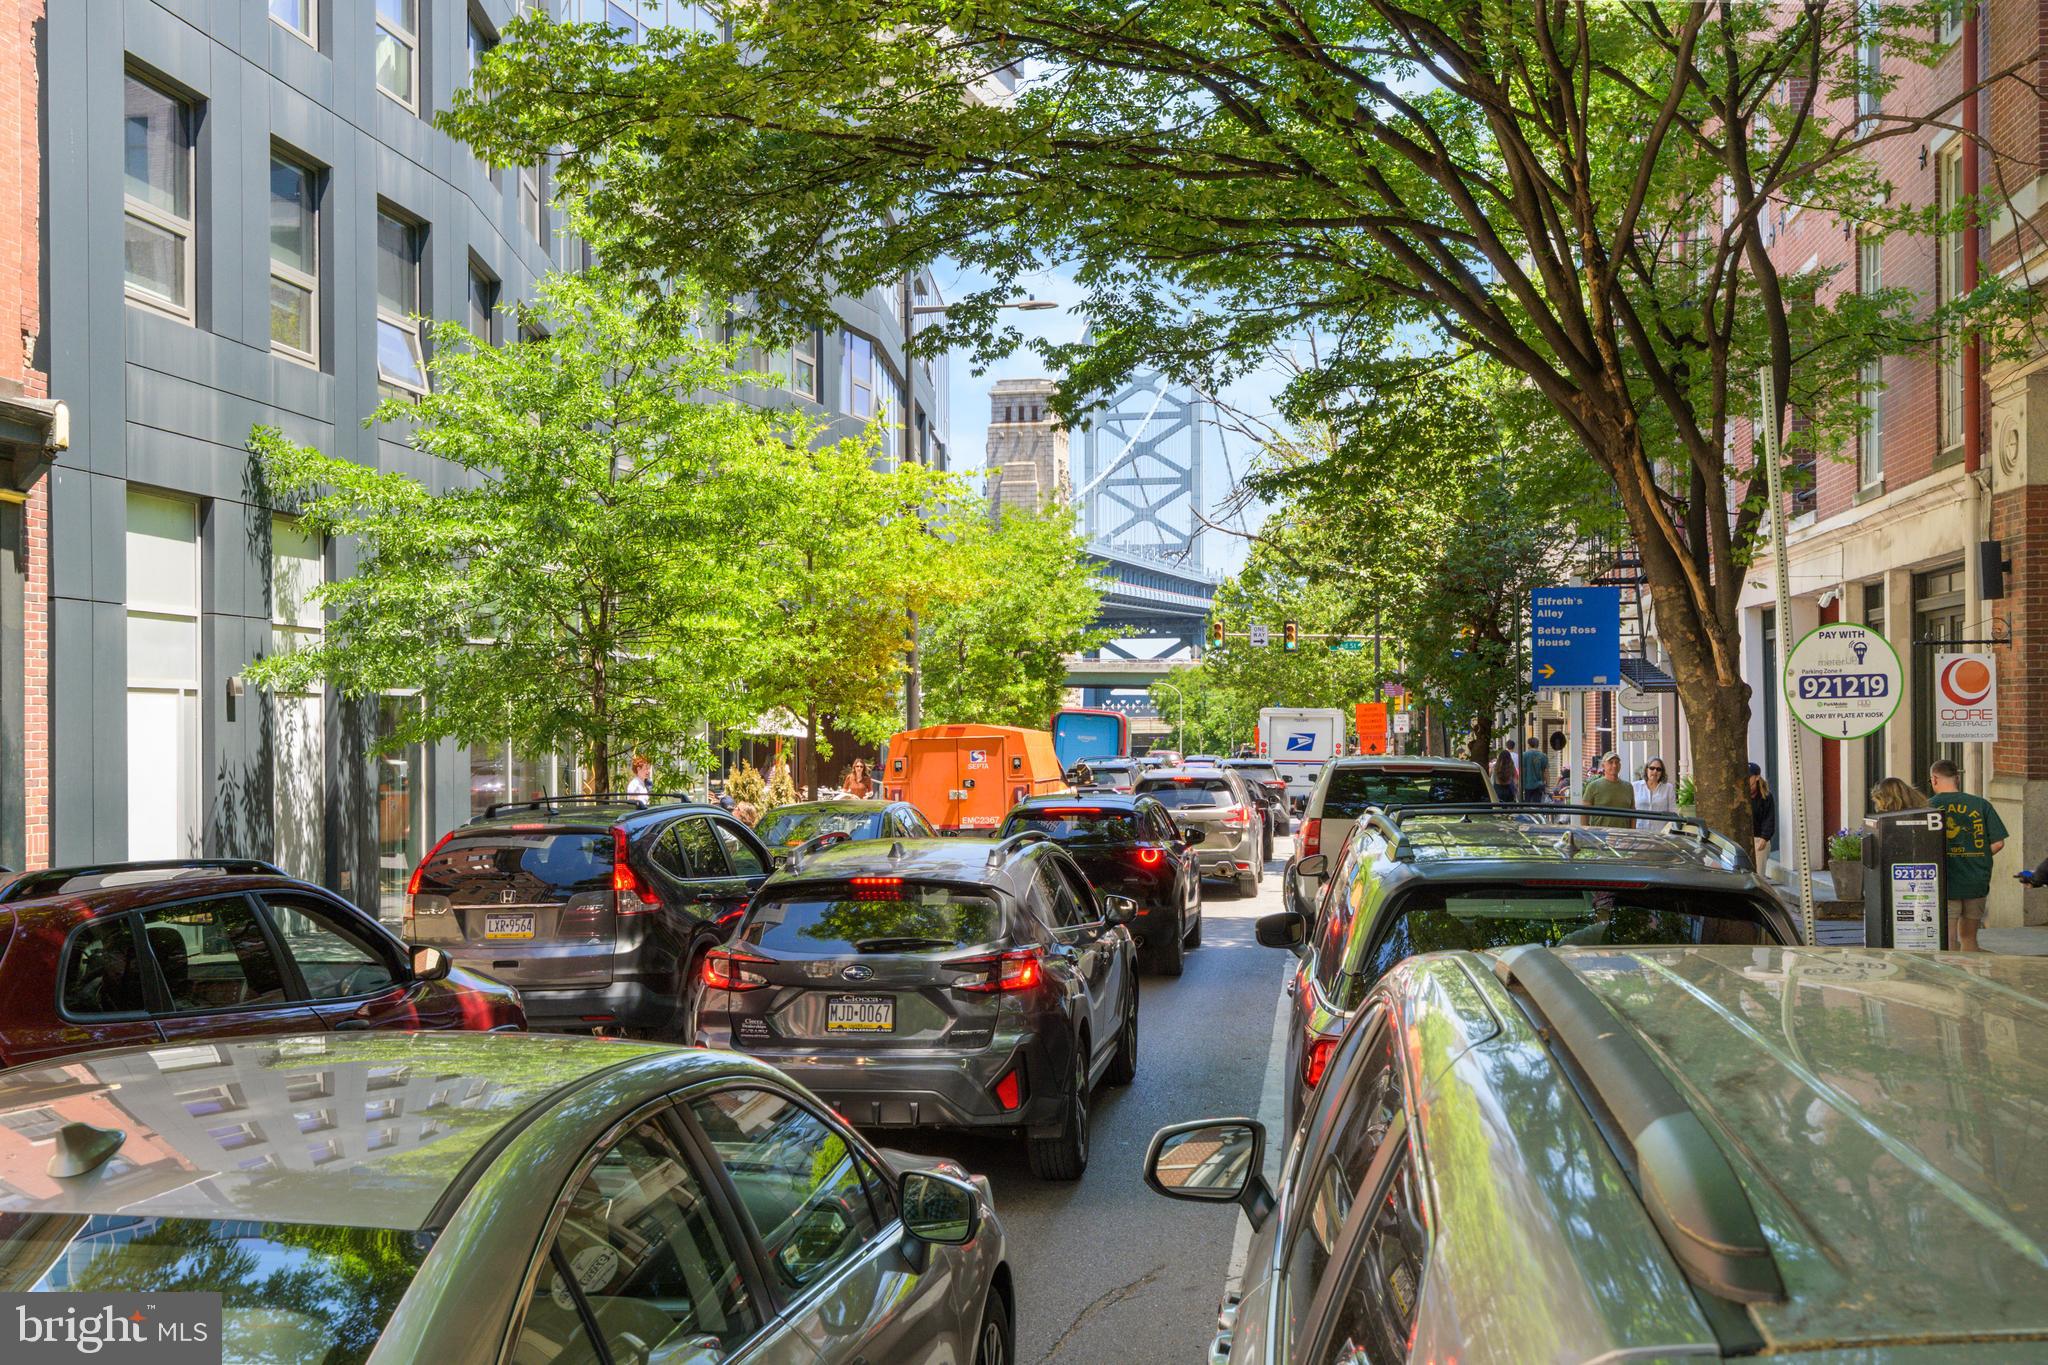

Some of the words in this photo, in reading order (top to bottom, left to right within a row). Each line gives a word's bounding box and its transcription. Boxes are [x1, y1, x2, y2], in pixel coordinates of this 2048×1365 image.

[1537, 597, 1583, 606] Elfreth's
[1537, 610, 1563, 619] Alley
[1537, 626, 1567, 636] Betsy
[1570, 626, 1597, 634] Ross
[1819, 631, 1837, 639] PAY
[1839, 630, 1865, 639] WITH
[1537, 639, 1571, 647] House
[1803, 675, 1885, 698] 921219
[1941, 709, 1993, 720] CORE
[962, 816, 1000, 824] EMC2367
[1927, 812, 1943, 831] B
[1894, 869, 1936, 879] 921219
